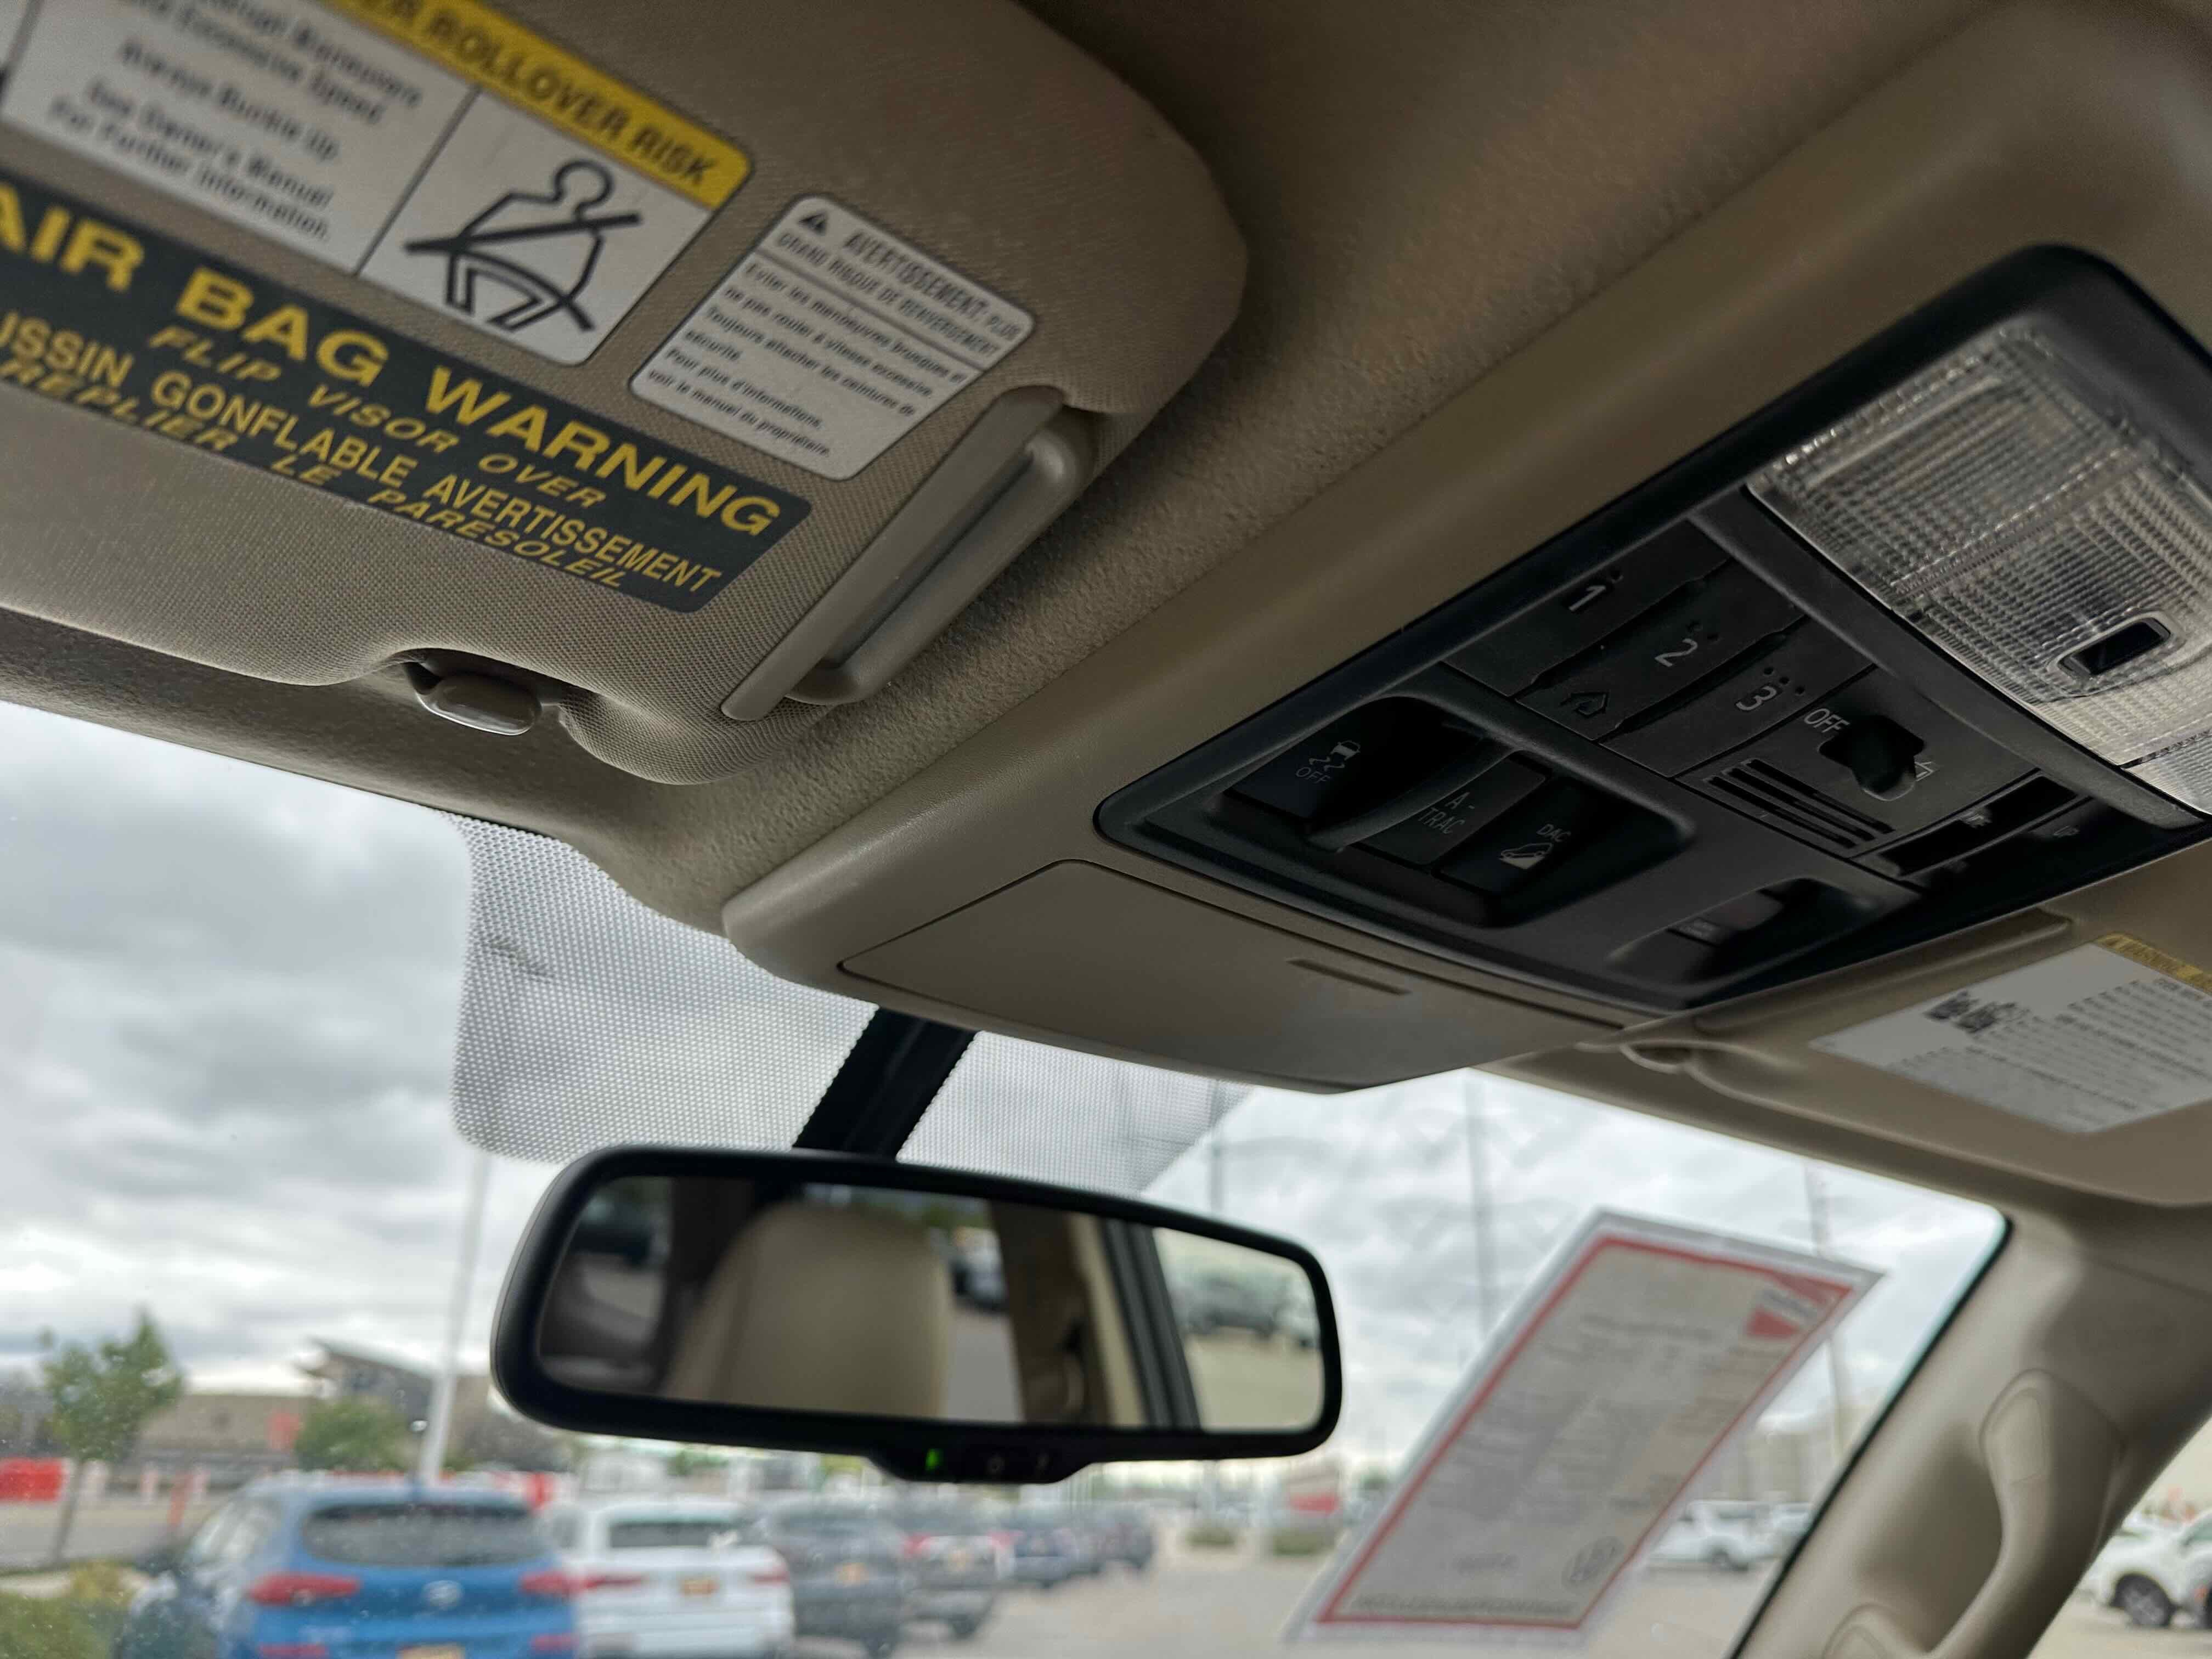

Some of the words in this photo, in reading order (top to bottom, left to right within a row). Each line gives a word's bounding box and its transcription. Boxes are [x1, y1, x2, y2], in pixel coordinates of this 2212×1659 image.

[427, 8, 631, 143] ROLLOVER
[627, 124, 719, 185] RISK
[724, 288, 744, 303] ne
[175, 266, 390, 387] BAG
[426, 365, 781, 537] WARNING
[690, 389, 742, 419] manuel
[149, 325, 281, 381] FLIP
[307, 385, 460, 454] VISOR
[477, 453, 607, 509] OVER
[151, 370, 419, 489] GONFLABLE
[422, 473, 723, 592] AVERTISSEMENT
[270, 454, 341, 486] LE
[366, 488, 627, 588] PARESOLEIL
[1567, 584, 1607, 613] 1
[1654, 637, 1699, 668] 2
[1735, 685, 1779, 712] 3
[1803, 707, 1851, 733] OFF
[1294, 766, 1333, 785] OFF
[1416, 806, 1466, 835] TRAC
[1536, 823, 1571, 844] DAC
